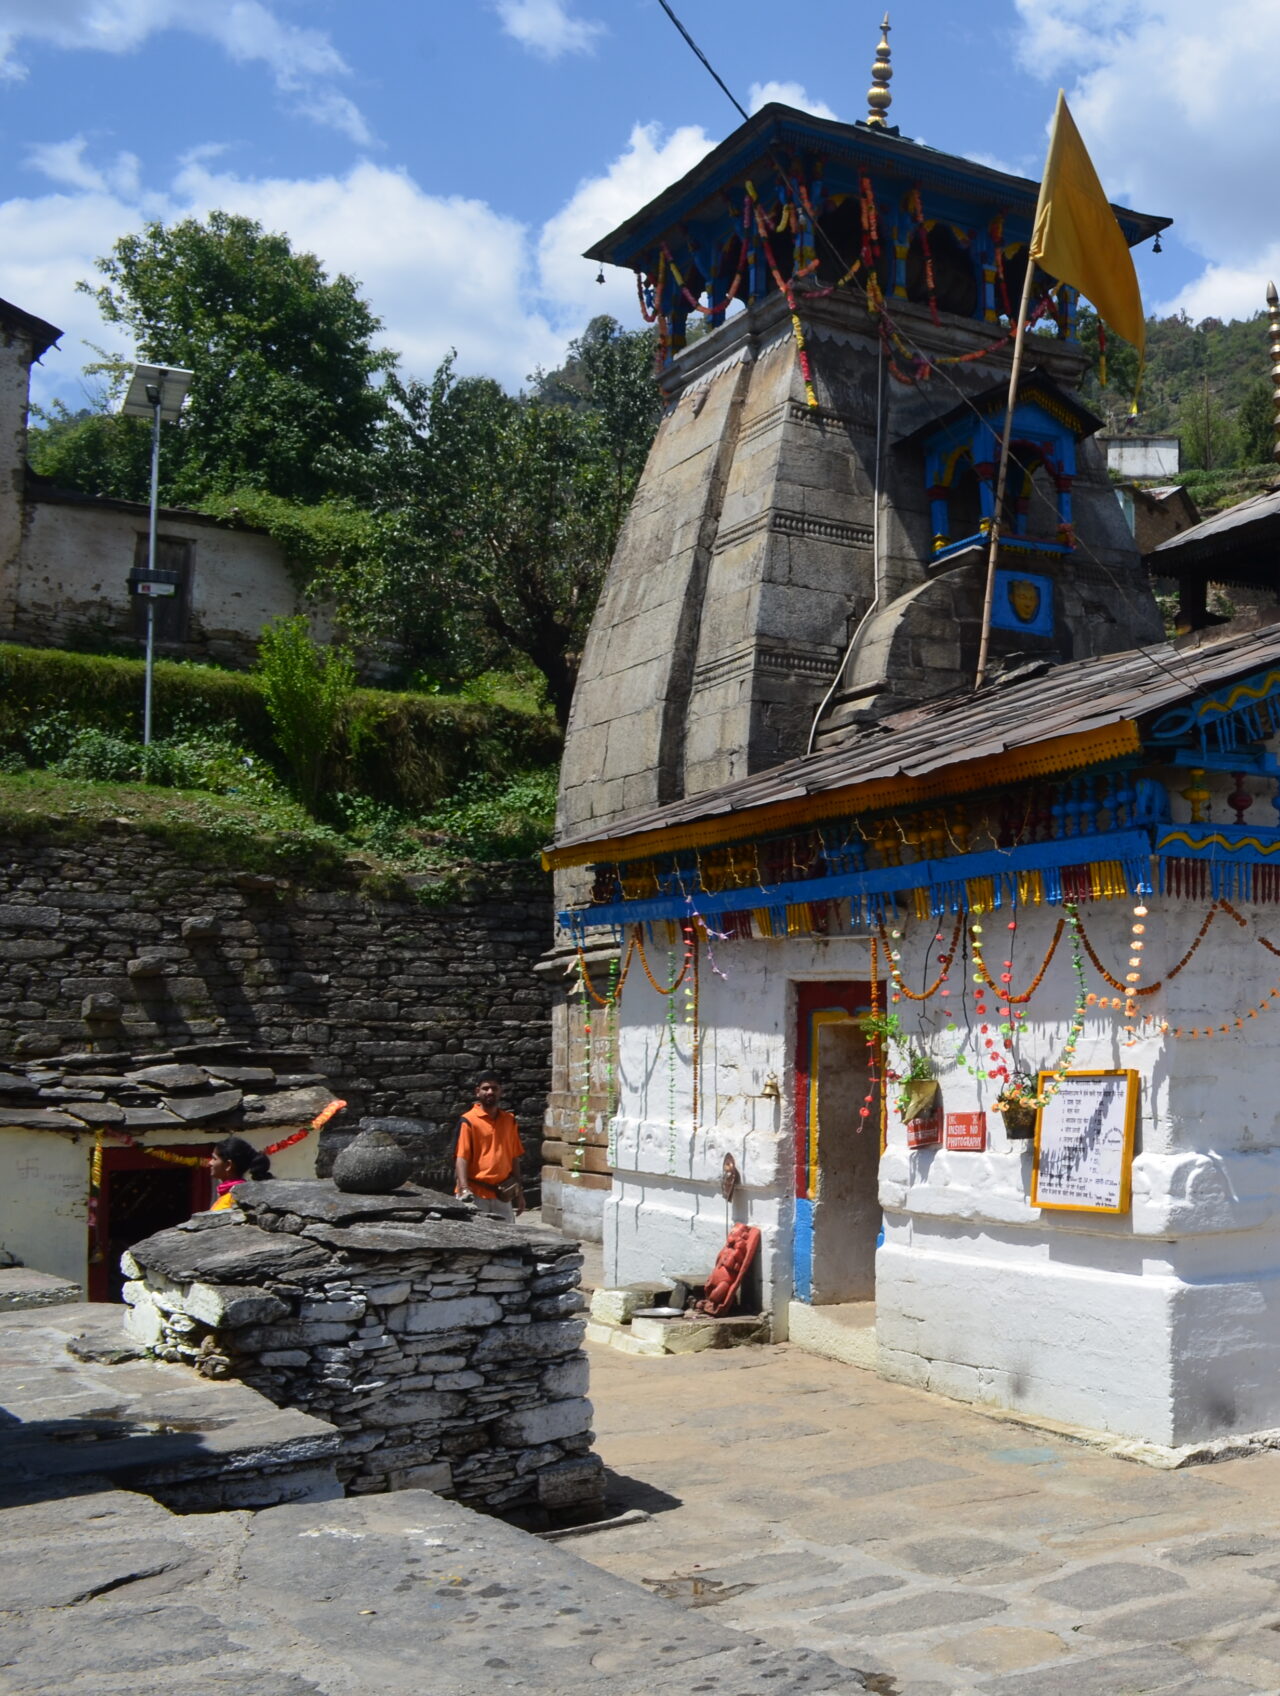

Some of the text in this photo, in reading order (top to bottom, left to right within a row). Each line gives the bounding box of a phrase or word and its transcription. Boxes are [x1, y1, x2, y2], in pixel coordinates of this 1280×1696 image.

[948, 1125, 967, 1135] INSIDE
[970, 1125, 978, 1134] NO
[947, 1136, 982, 1147] PHOTOGRAPHY
